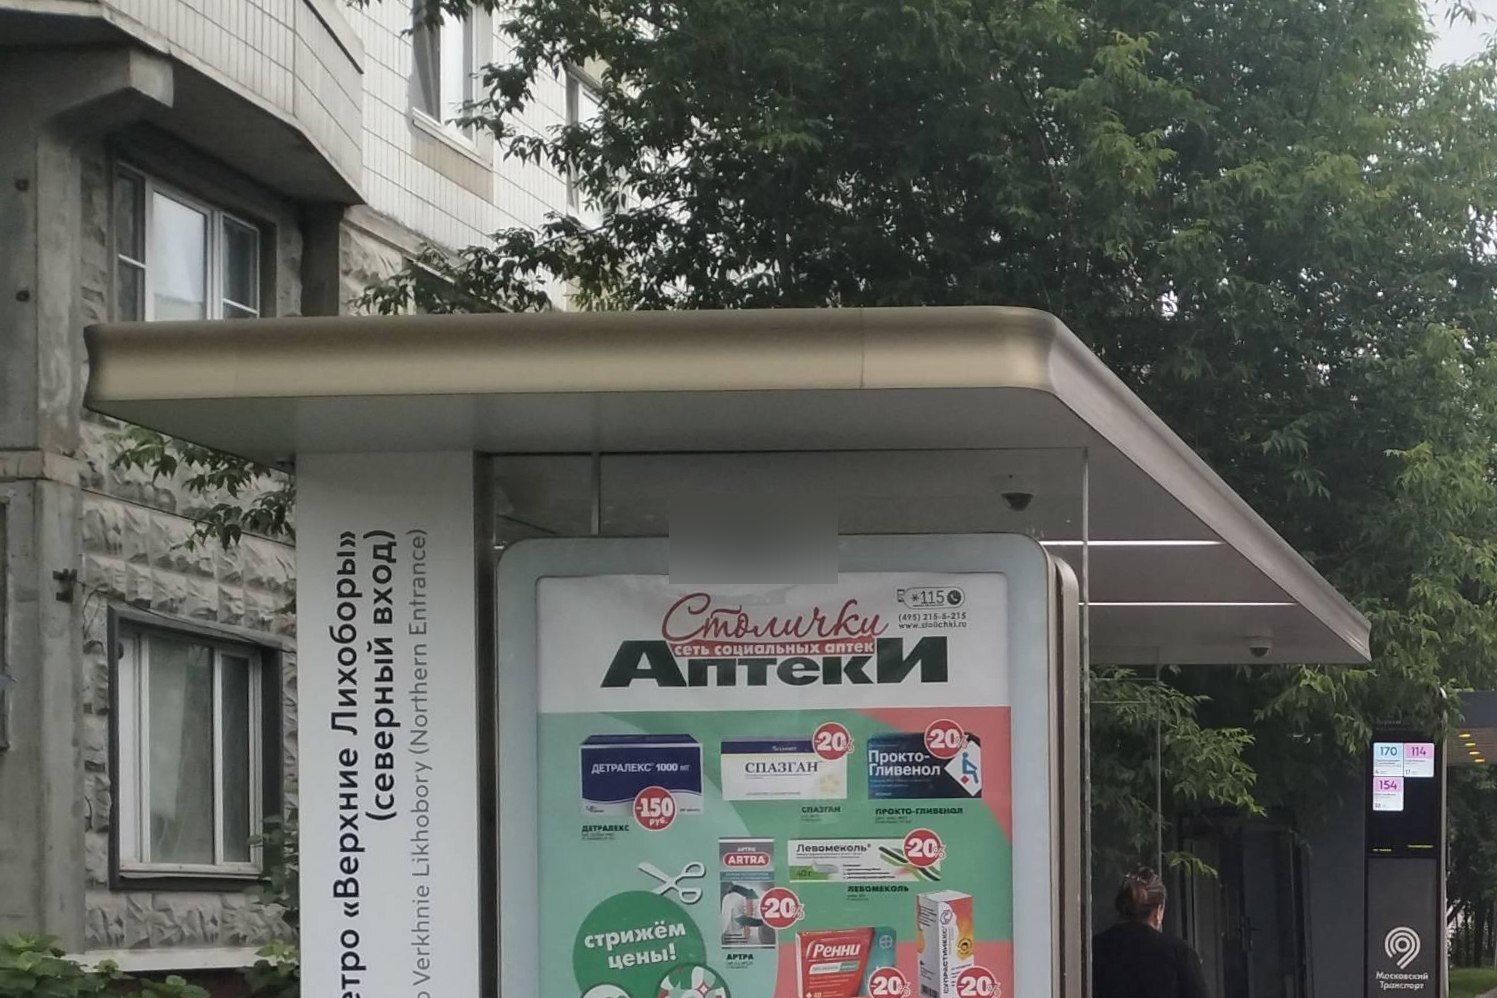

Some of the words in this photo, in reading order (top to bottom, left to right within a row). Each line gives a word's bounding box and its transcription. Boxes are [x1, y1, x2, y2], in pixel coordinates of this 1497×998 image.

[362, 529, 398, 625] вход)
[405, 528, 428, 636] Entrance)
[661, 592, 889, 642] Столички
[328, 530, 363, 736] Лихоборы»
[674, 644, 709, 657] сеть
[714, 642, 820, 657] социальных
[825, 641, 875, 655] аптек
[408, 642, 430, 755] (Northern
[364, 636, 401, 821] (северный
[868, 750, 930, 765] Прокто-
[1380, 746, 1398, 756] 170
[1411, 746, 1427, 757] 114
[591, 763, 652, 774] ДЕТРАЛЕКС
[656, 763, 678, 772] 1000
[745, 761, 818, 774] СПАЗГАН
[868, 764, 941, 776] Гливенол
[1379, 780, 1397, 790] 154
[635, 797, 674, 818] -150
[801, 806, 841, 814] СПАЗГАН
[875, 807, 963, 815] ПРОКТО-ГЛИВЕНОЛ
[410, 761, 433, 877] Likhobory
[332, 747, 366, 918] «Верхние
[728, 855, 766, 865] ARTRA
[847, 885, 910, 893] ЛЕВОМЕКОЛЬ
[411, 884, 431, 987] Verkhnie
[584, 920, 686, 951] стрижём
[607, 942, 677, 970] цены!
[812, 943, 861, 958] Ренни
[1375, 971, 1429, 980] Московский
[1379, 980, 1425, 991] Транспорт
